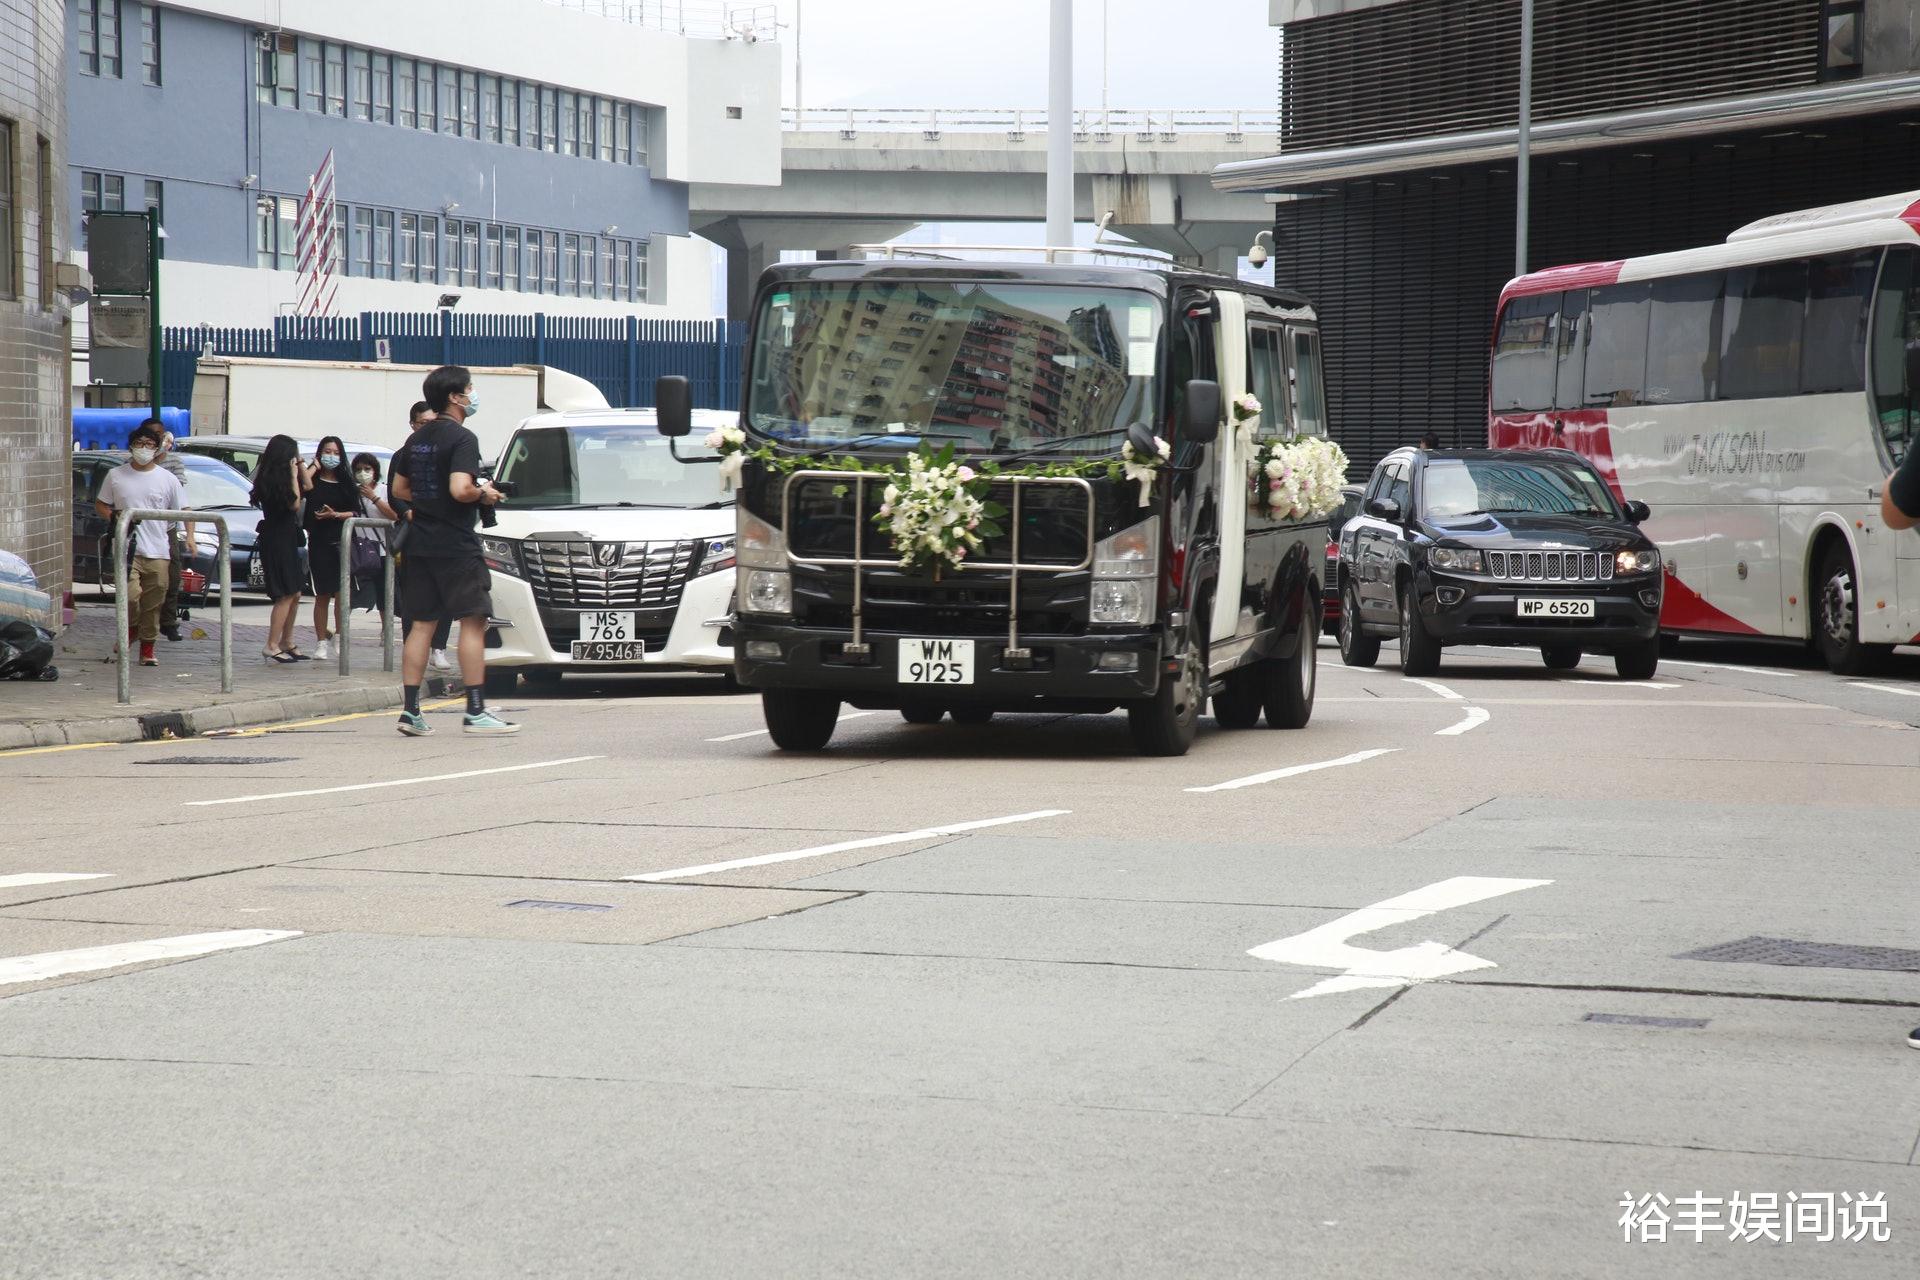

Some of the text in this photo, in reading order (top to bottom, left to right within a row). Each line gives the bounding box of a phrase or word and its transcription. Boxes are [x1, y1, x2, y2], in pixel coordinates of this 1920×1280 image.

[1523, 601, 1589, 615] WP 6520
[596, 612, 618, 626] MS
[590, 626, 625, 640] 766
[921, 640, 953, 661] WM
[909, 662, 963, 682] 9125
